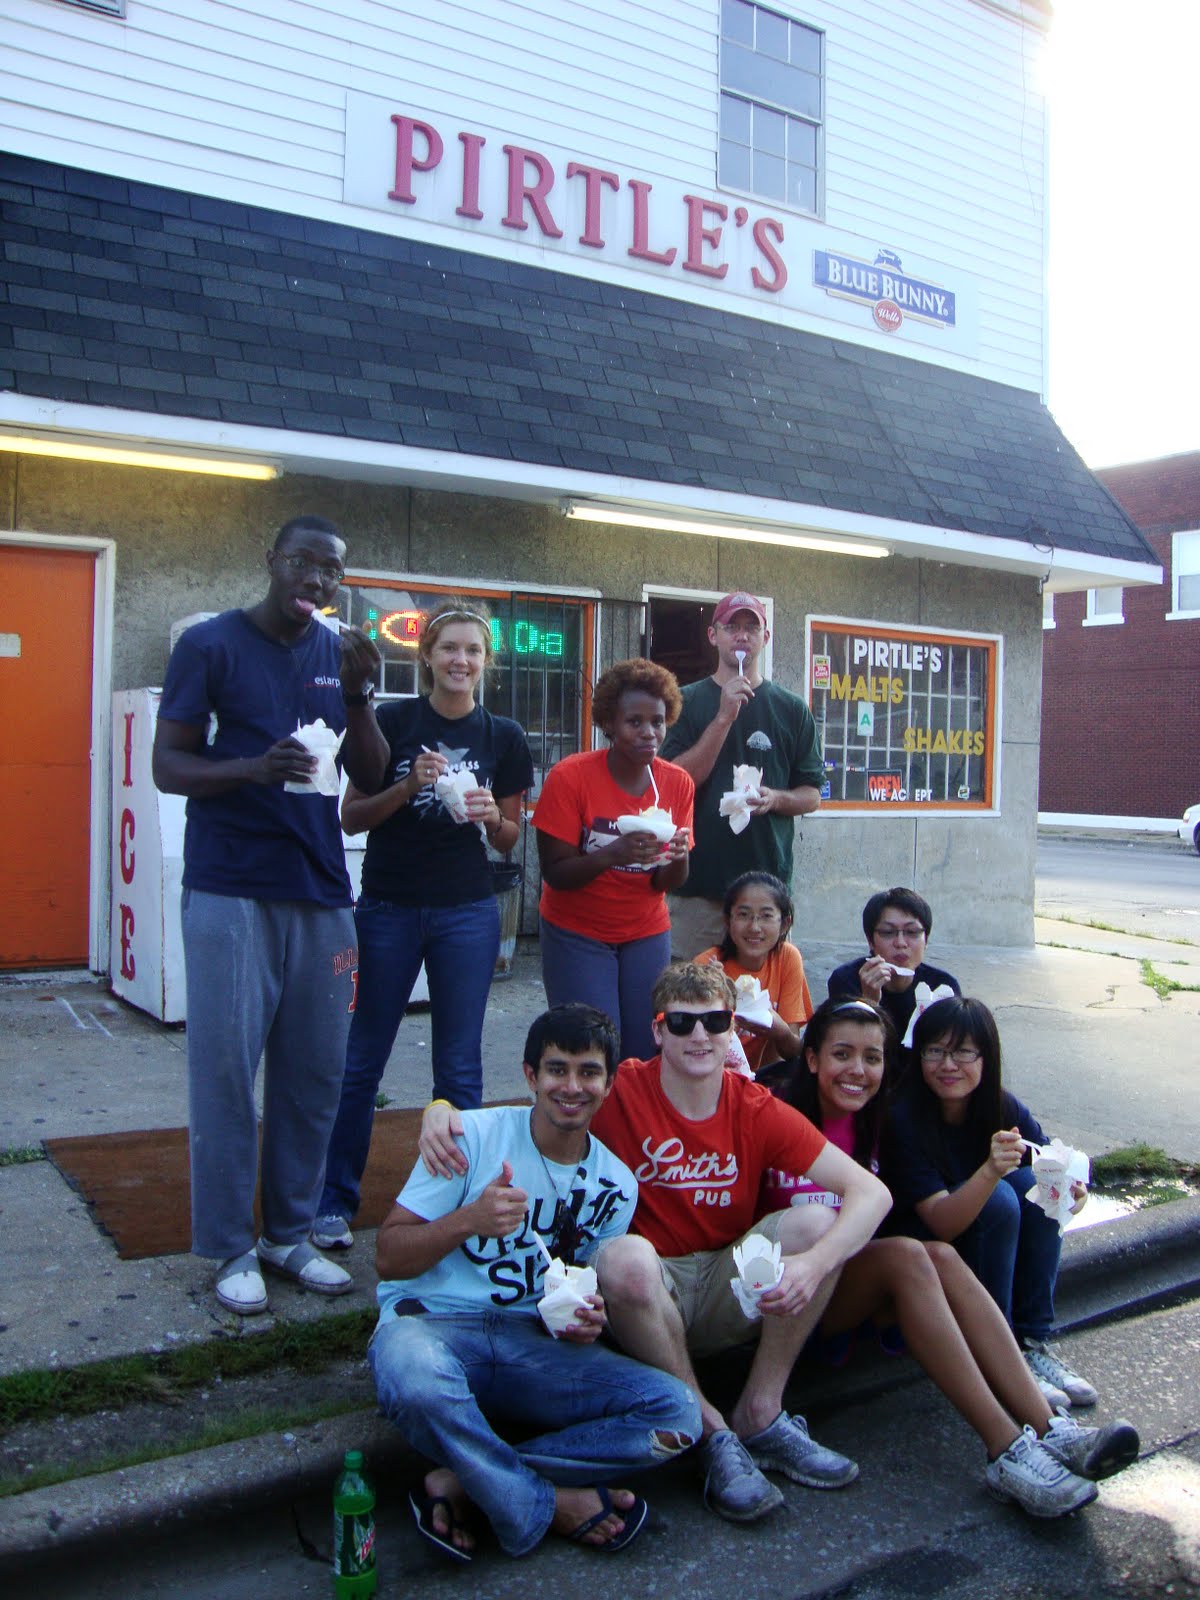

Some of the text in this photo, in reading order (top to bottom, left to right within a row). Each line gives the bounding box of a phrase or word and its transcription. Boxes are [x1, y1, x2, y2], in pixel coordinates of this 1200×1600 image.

[388, 113, 788, 293] PIRTLE'S
[828, 258, 879, 296] BLUE
[853, 638, 942, 673] PIRTLE'S
[831, 673, 904, 704] MALTS
[860, 714, 871, 726] A
[903, 727, 985, 756] SHAKES
[868, 774, 901, 797] OPEN
[870, 788, 887, 801] WE
[119, 713, 136, 981] ICE
[634, 1135, 739, 1186] Smith's
[694, 1189, 731, 1207] PUB
